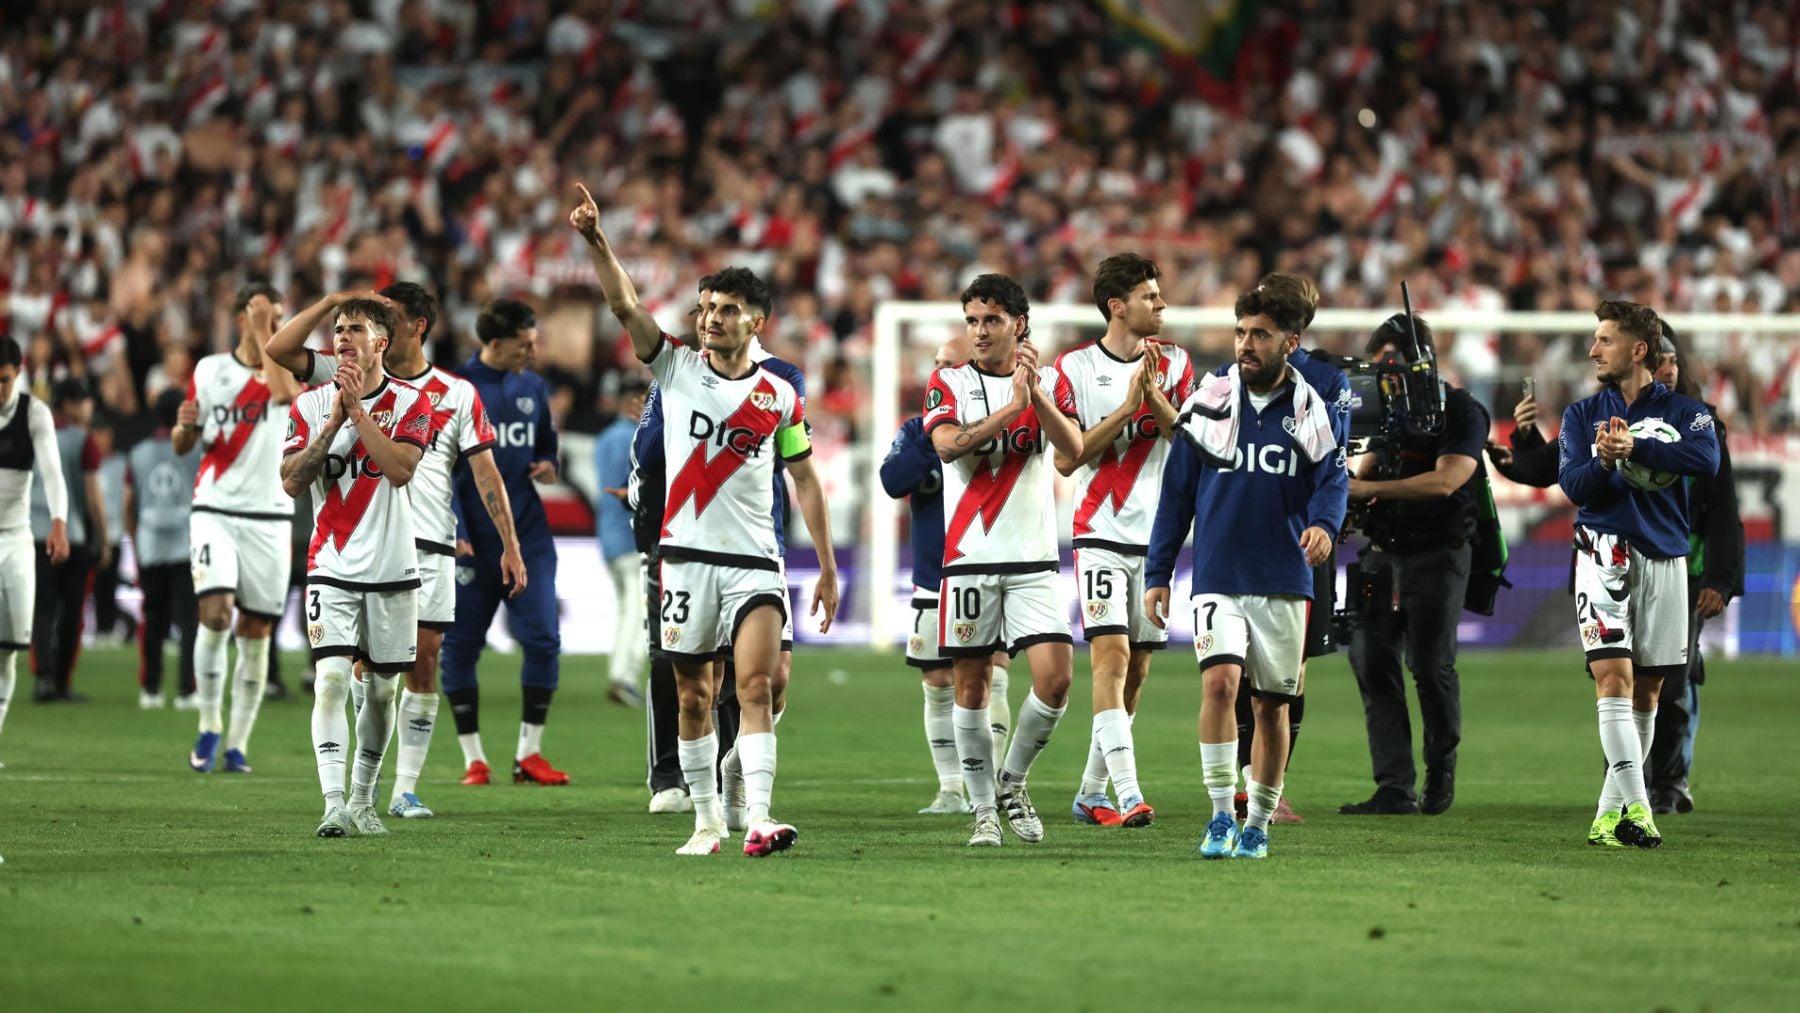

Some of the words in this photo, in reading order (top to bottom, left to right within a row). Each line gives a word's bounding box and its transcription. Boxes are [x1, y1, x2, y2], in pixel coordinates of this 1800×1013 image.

[492, 422, 535, 448] IGI
[689, 410, 768, 458] DIGI
[1100, 413, 1161, 440] IG
[1084, 570, 1113, 600] 15
[309, 590, 321, 621] 3
[661, 589, 691, 623] 23
[952, 587, 980, 620] 10
[1193, 601, 1218, 636] 17
